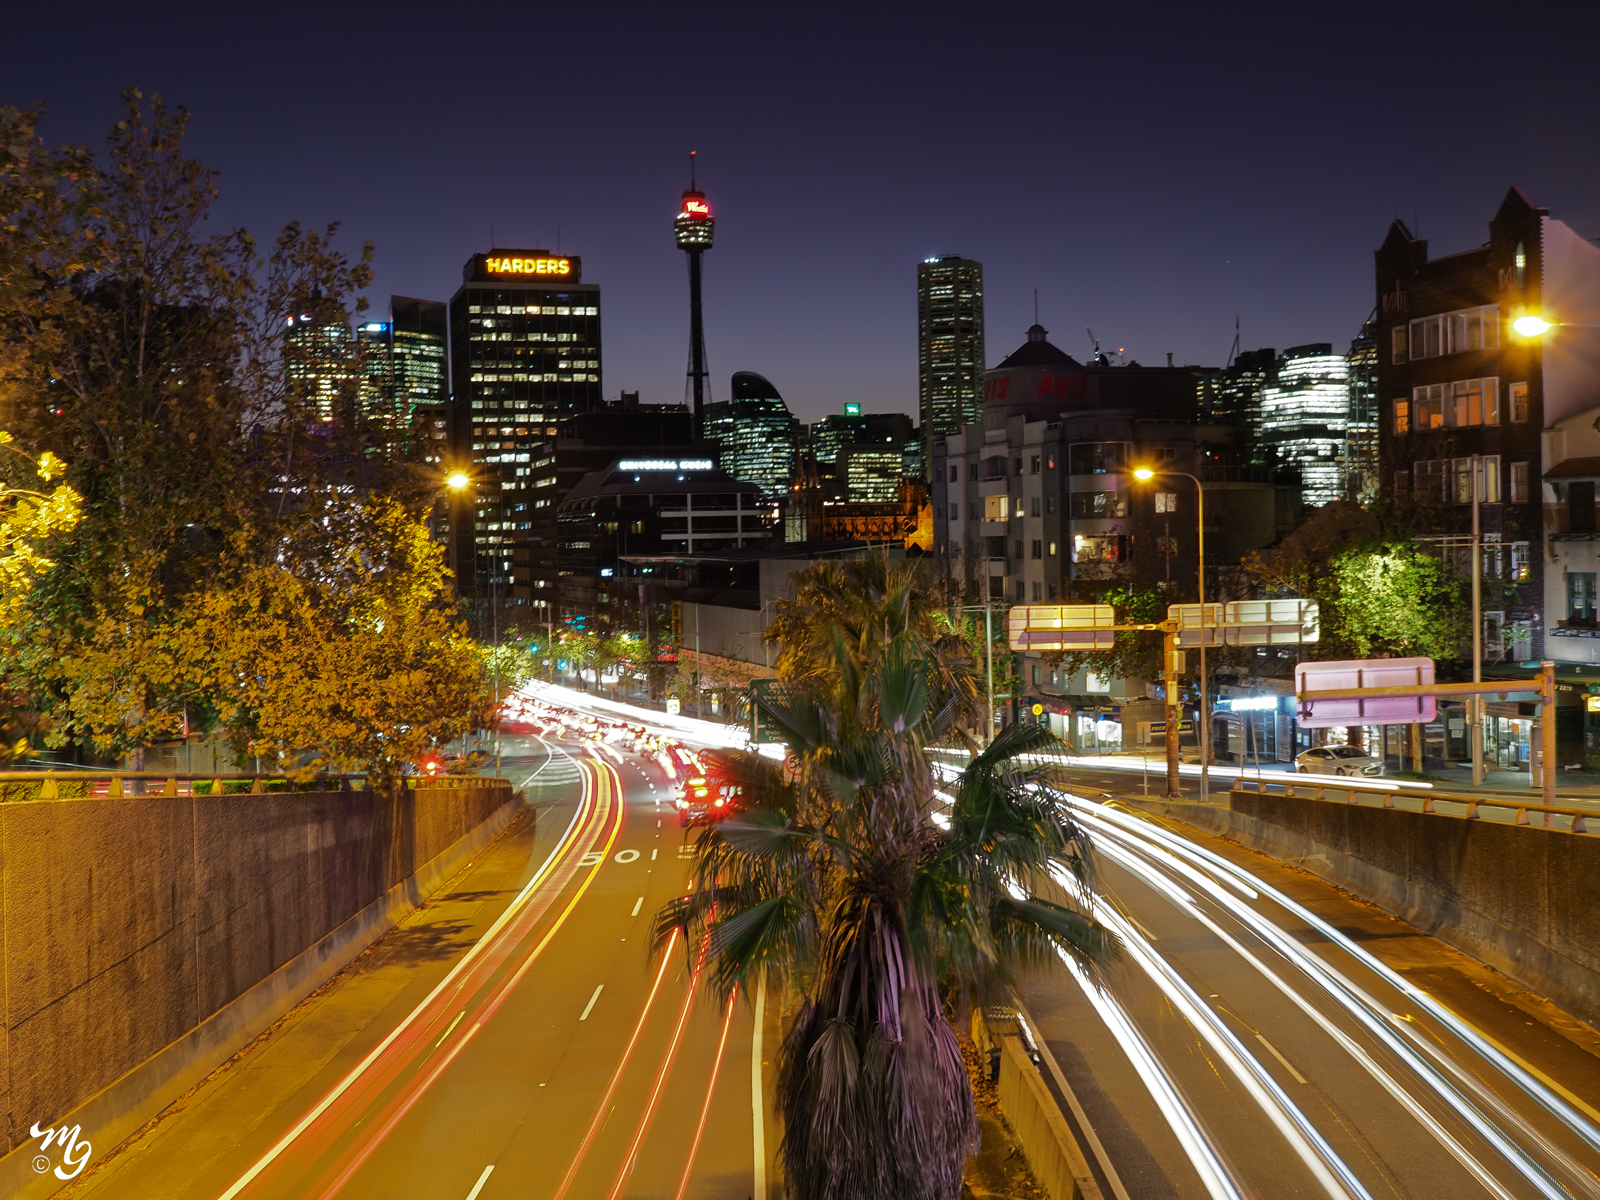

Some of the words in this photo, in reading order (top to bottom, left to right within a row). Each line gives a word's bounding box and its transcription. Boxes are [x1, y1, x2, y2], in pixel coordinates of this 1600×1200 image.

[486, 258, 570, 274] HARDERS
[984, 378, 1010, 401] VIS
[1036, 375, 1088, 397] AVIS
[576, 849, 640, 867] 50
